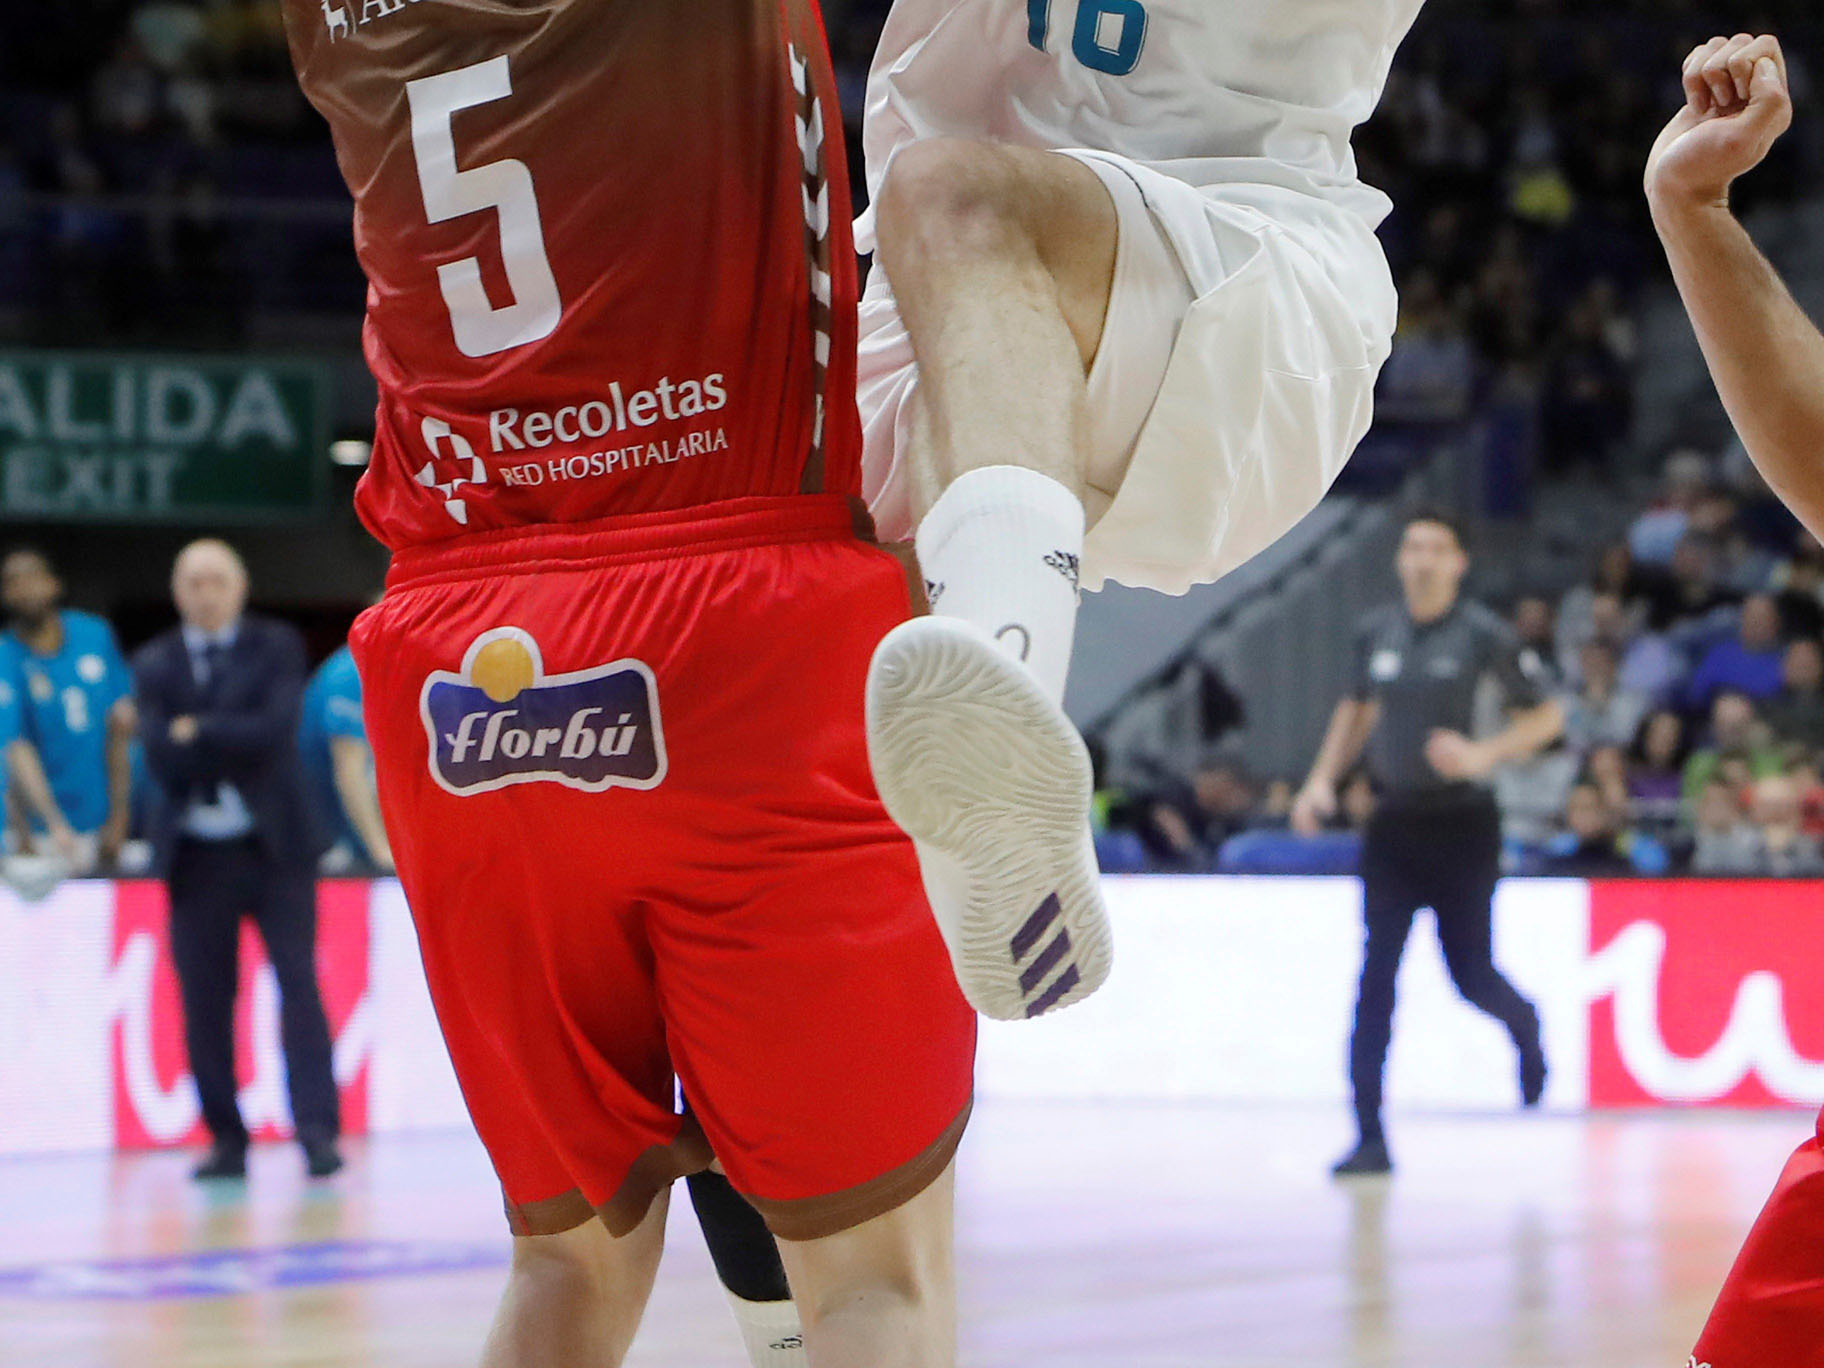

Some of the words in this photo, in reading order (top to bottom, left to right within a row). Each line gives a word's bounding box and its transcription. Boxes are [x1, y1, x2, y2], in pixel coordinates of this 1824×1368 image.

[405, 54, 563, 358] 5
[490, 373, 728, 453] Recoletas
[4, 444, 184, 513] EXIT
[499, 464, 544, 487] RED
[548, 428, 729, 482] HOSPITALARIA
